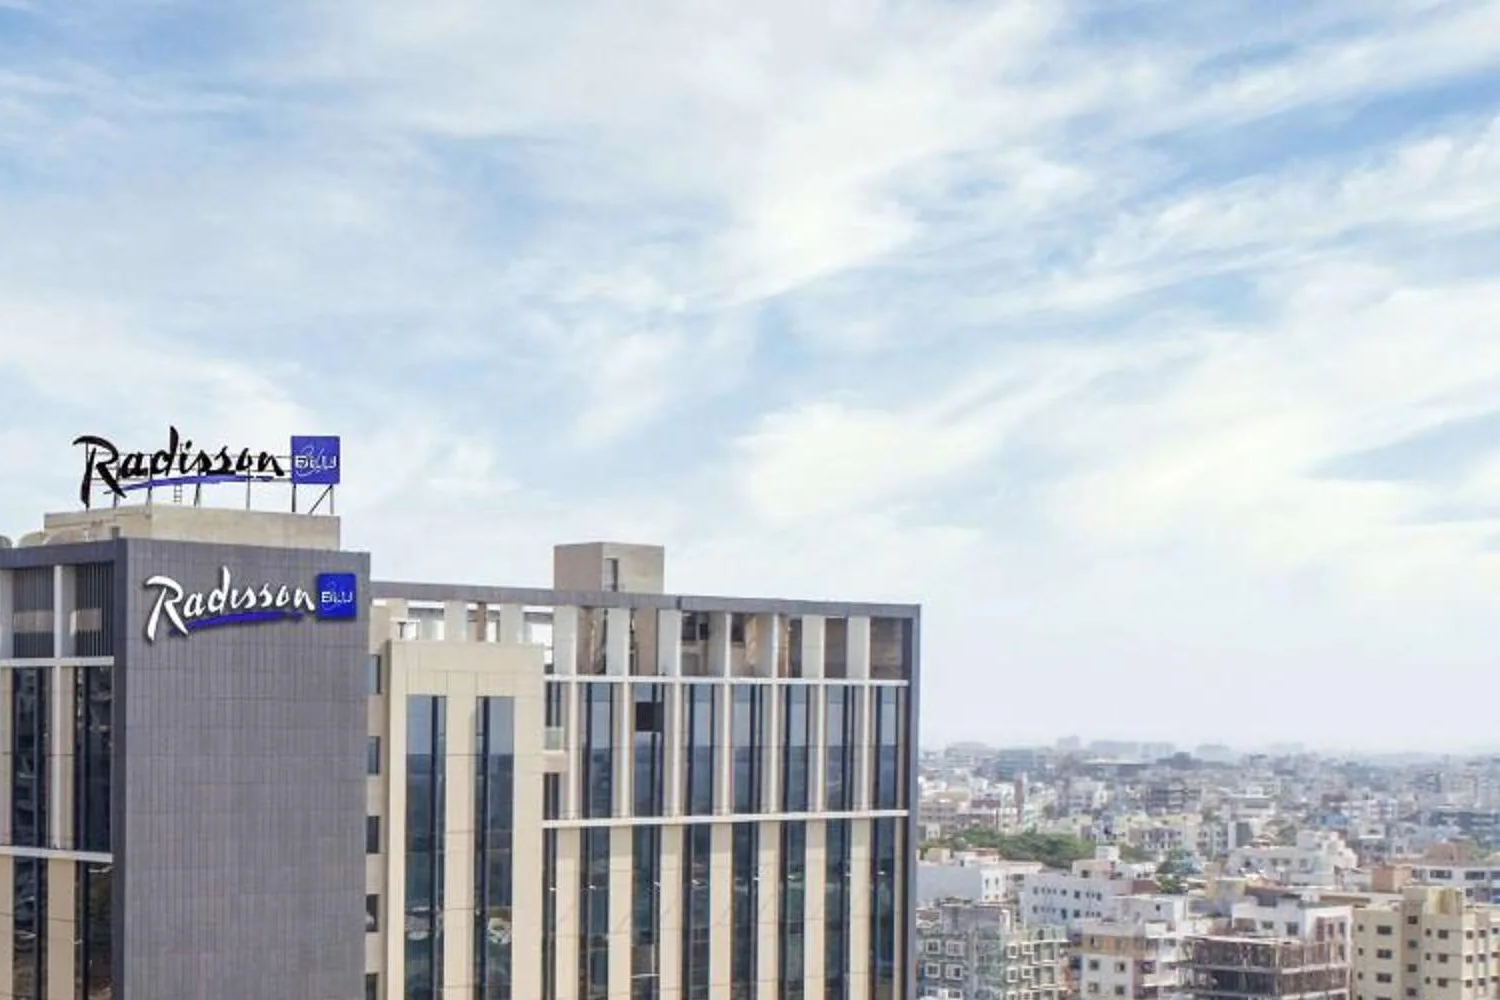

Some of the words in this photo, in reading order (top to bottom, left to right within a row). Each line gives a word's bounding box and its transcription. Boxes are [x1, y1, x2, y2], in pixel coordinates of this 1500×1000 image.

[72, 425, 284, 505] Radisson
[295, 455, 337, 469] BLU
[145, 565, 315, 641] Radisson
[321, 591, 353, 603] BLU
